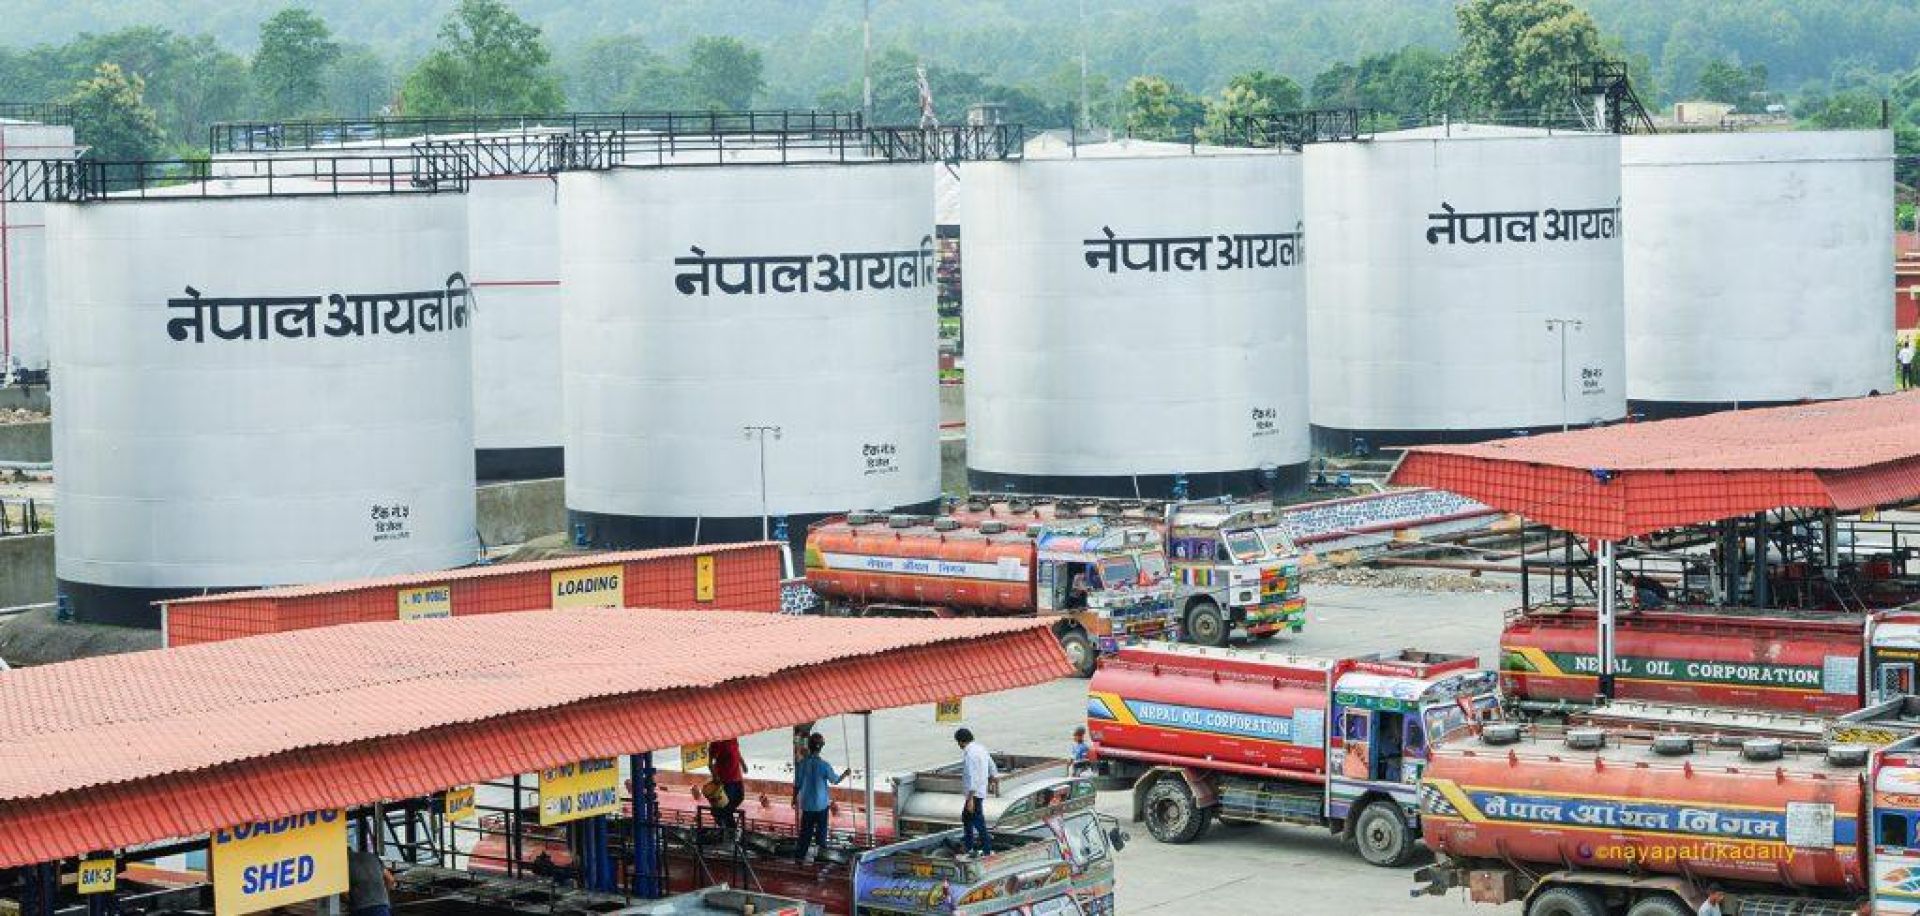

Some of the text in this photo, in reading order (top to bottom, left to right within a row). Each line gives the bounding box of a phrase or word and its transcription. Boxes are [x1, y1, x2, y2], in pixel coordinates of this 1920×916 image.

[1427, 202, 1615, 244] नेपाल आयल
[1083, 225, 1293, 273] नेपाल आयल
[674, 244, 812, 296] नेपाल
[814, 250, 919, 292] आयल
[167, 285, 322, 343] नेपाल
[324, 290, 444, 336] आयल
[558, 575, 617, 597] LOADING
[1575, 656, 1632, 674] NEAL
[1646, 660, 1675, 677] OIL
[1687, 662, 1819, 684] CORPORATION
[1140, 704, 1178, 722] NEPAL
[1182, 711, 1201, 726] OIL
[1207, 713, 1290, 736] CORPORATION
[560, 786, 616, 816] NO SMOKING
[1679, 809, 1780, 837] निगम
[82, 867, 112, 885] BAY-3
[242, 855, 316, 895] SHED
